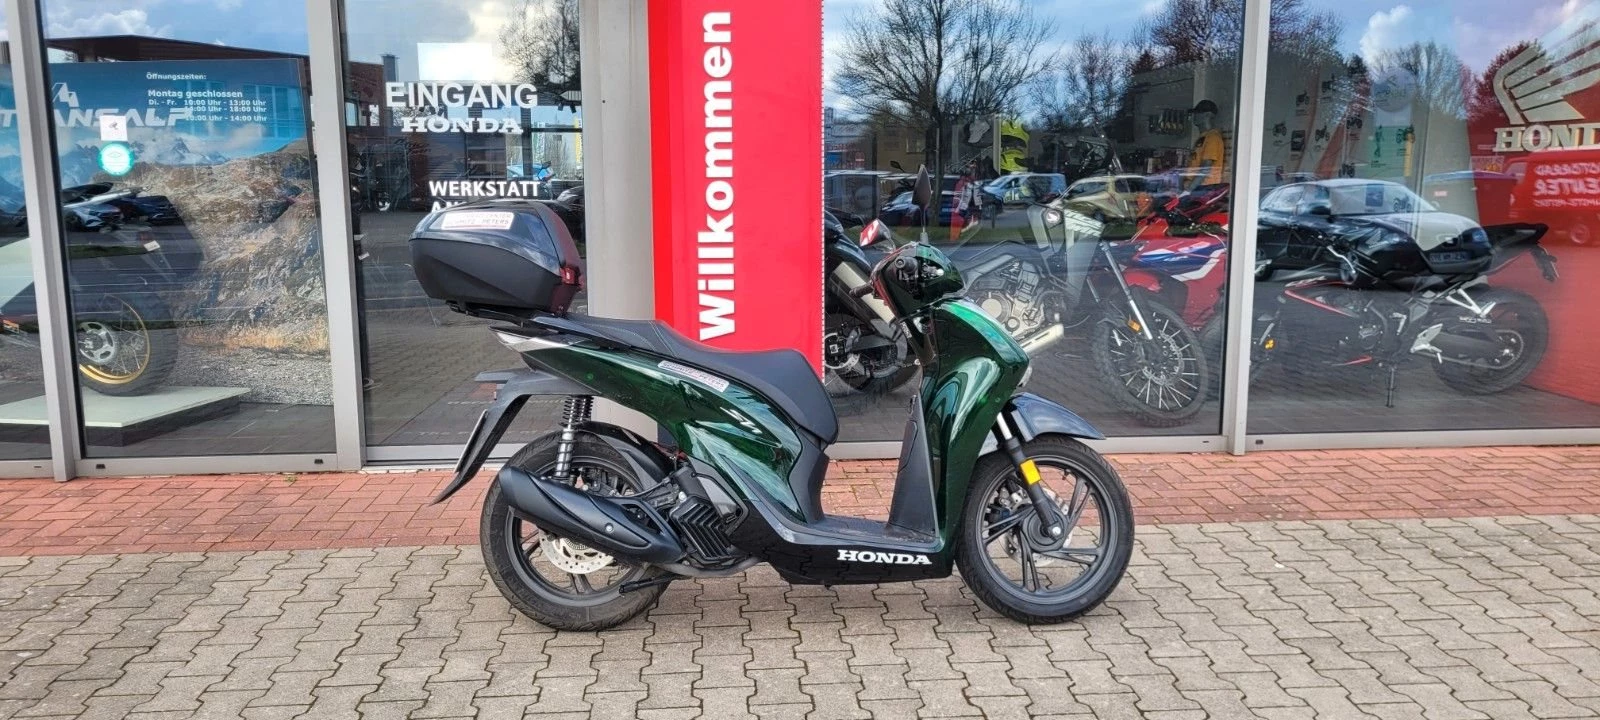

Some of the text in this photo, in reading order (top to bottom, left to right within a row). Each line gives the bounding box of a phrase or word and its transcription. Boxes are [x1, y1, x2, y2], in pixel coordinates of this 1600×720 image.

[146, 71, 207, 81] Öffnungszeiten:
[148, 89, 243, 98] Montag geschlossen
[385, 82, 538, 109] EINGANG
[0, 108, 193, 127] TNSALP
[401, 116, 524, 134] HONDA
[698, 11, 735, 341] Willkommen
[429, 181, 541, 197] WERKSTATT
[836, 549, 933, 565] HONDA
